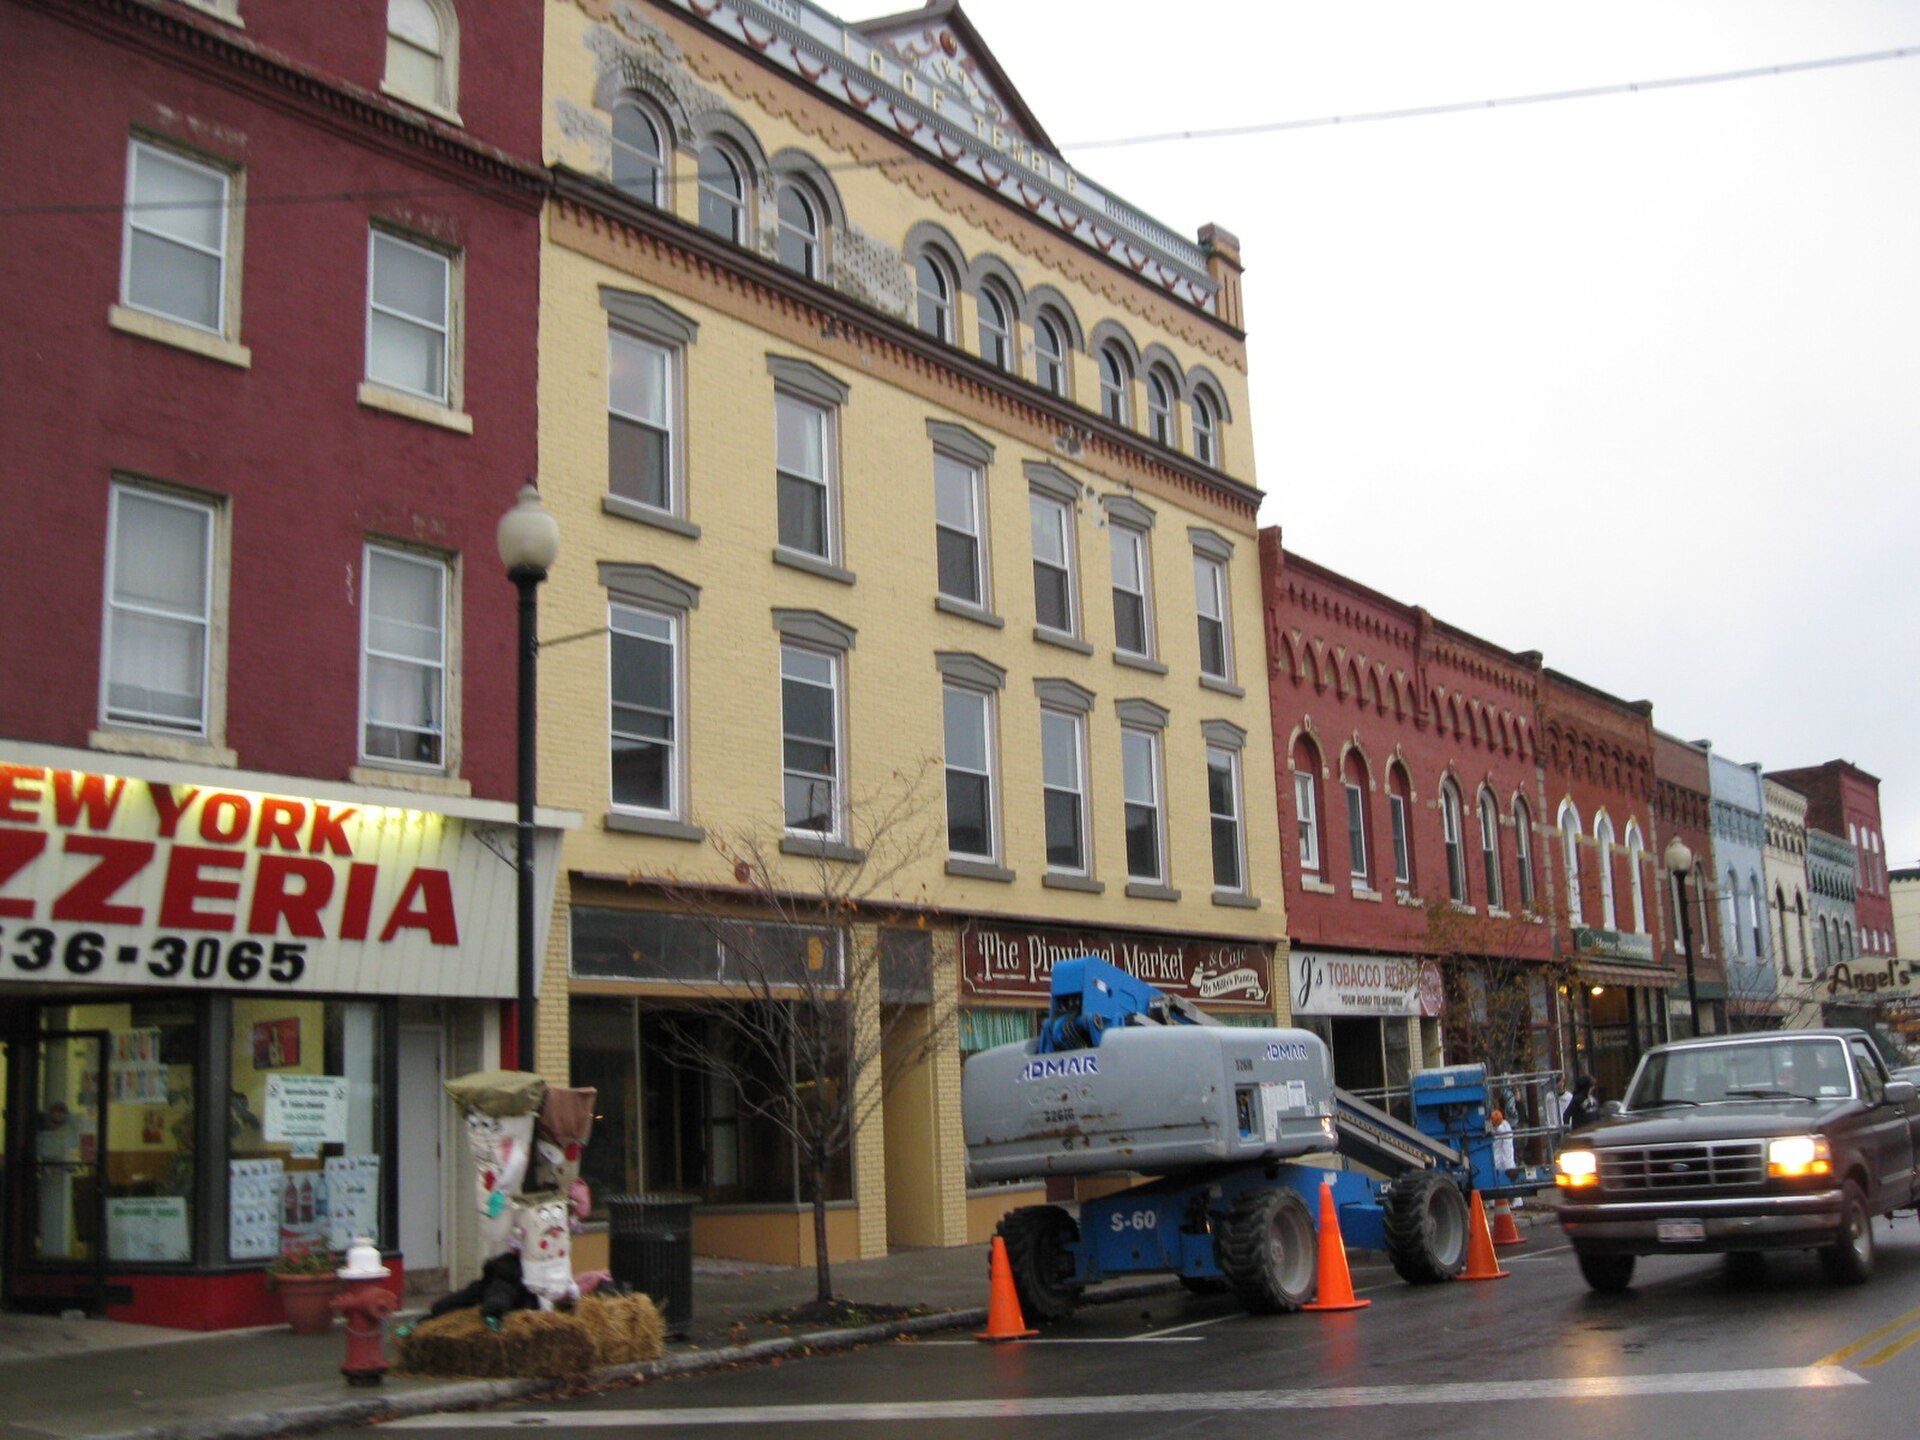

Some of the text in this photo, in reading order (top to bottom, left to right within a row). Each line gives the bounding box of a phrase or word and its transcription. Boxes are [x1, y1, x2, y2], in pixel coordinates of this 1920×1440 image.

[973, 112, 1077, 193] TEMPLE
[147, 780, 358, 857] YORK
[0, 926, 307, 983] 36-3065
[979, 931, 1185, 983] The Pinwhl Market
[1827, 959, 1911, 994] Angel's
[1299, 956, 1323, 1008] J's
[1327, 962, 1381, 988] TOBACCO
[1111, 1210, 1156, 1232] S-60
